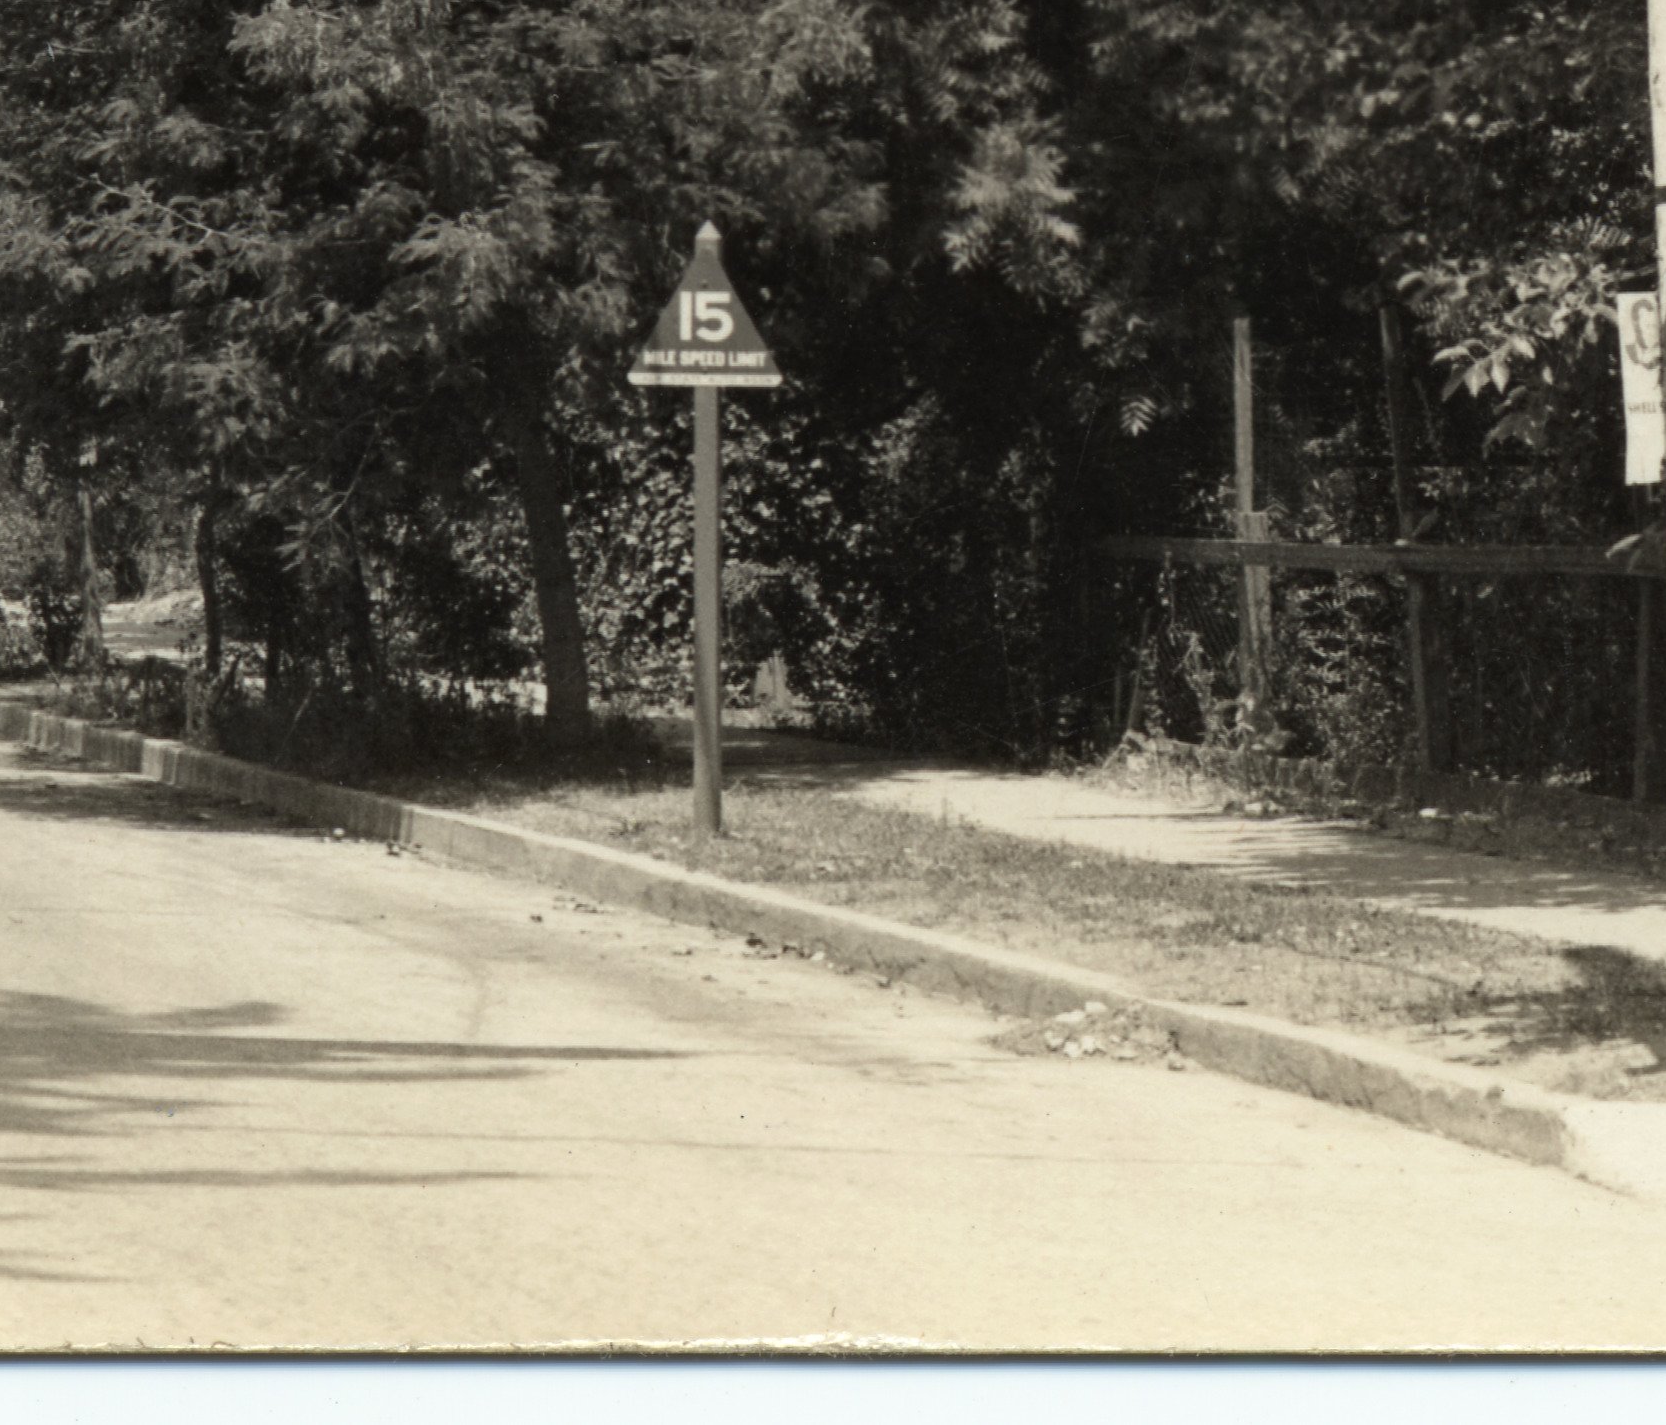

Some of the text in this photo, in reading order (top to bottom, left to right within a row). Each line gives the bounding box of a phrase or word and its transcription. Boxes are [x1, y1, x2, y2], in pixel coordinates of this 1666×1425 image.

[679, 290, 735, 342] 15
[680, 351, 726, 367] SPEED
[728, 352, 767, 367] LIMIT
